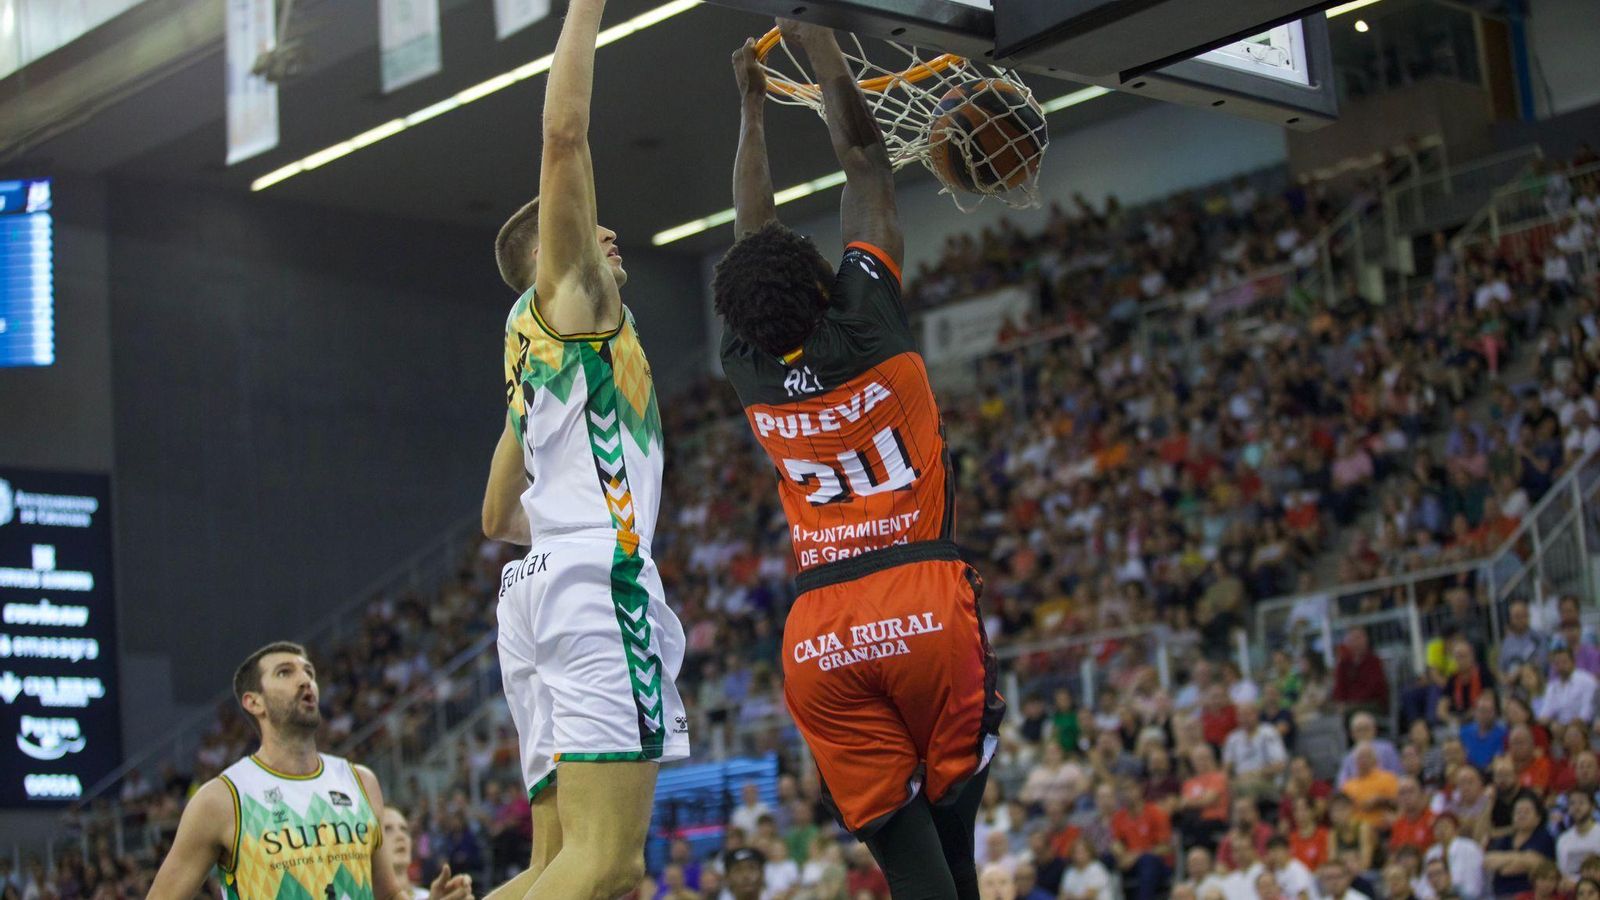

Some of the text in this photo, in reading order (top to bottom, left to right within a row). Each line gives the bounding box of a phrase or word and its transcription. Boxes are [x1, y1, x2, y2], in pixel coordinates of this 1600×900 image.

[754, 382, 892, 439] PULEVA
[800, 548, 819, 567] DE
[794, 612, 943, 663] CAJA RURAL
[818, 639, 911, 671] GRANADA
[263, 820, 369, 855] surne
[269, 856, 315, 871] seguros
